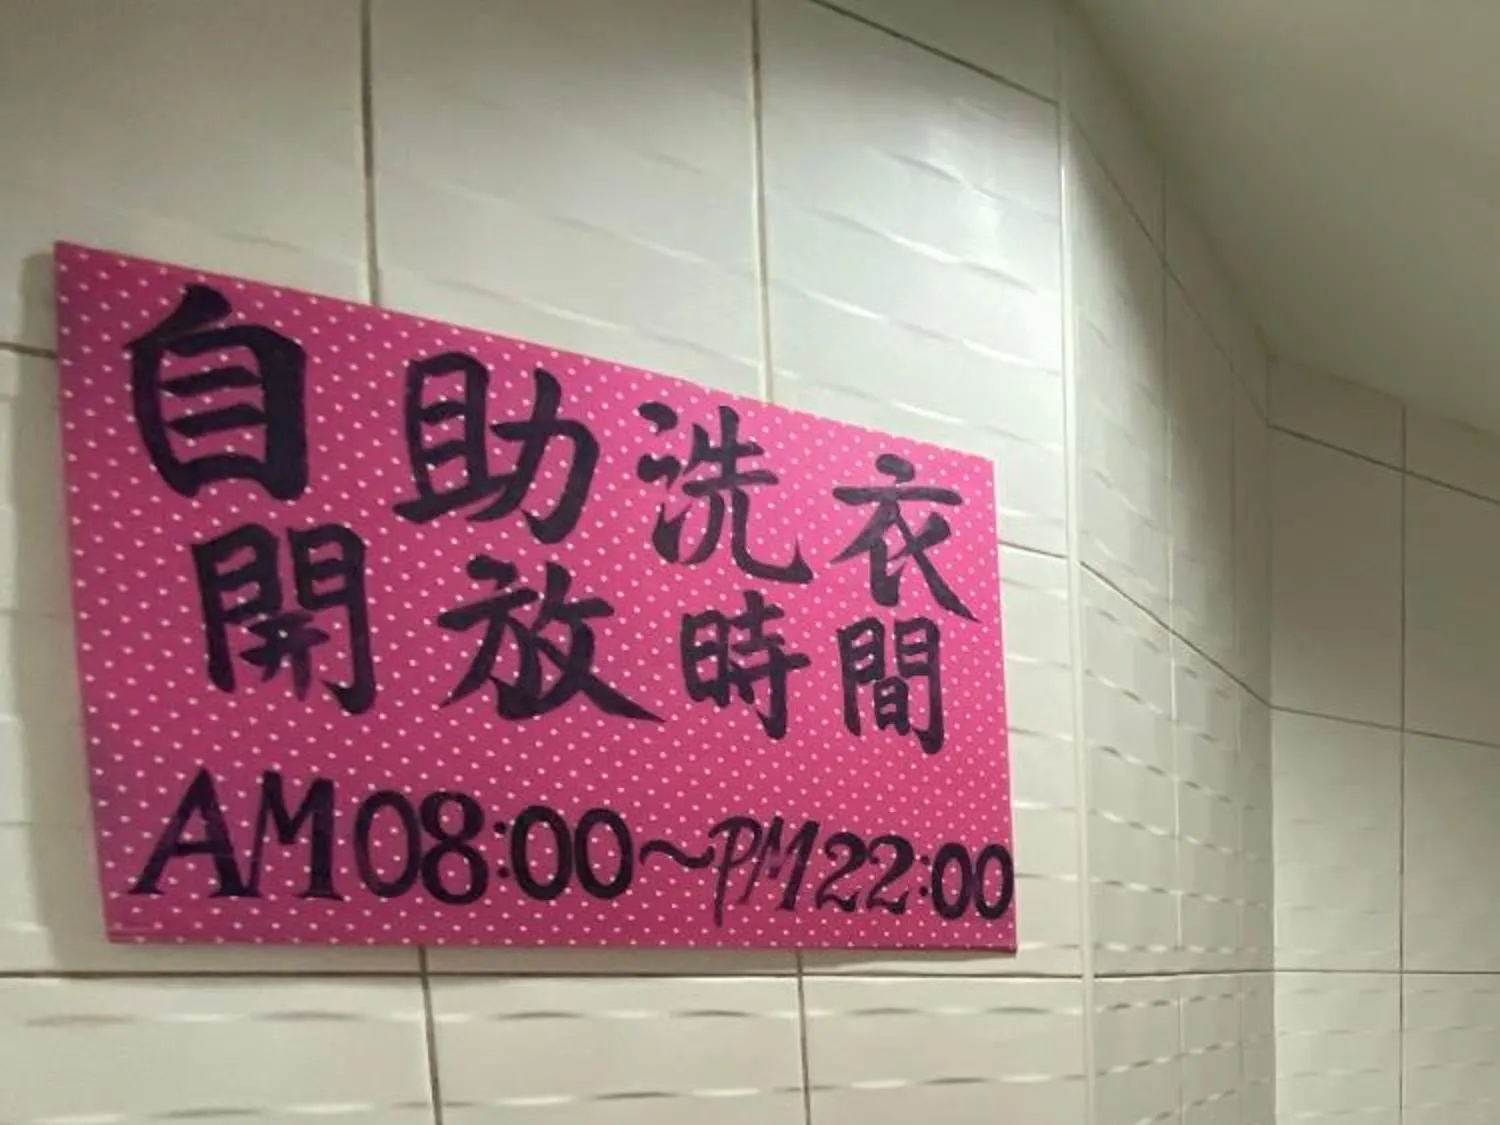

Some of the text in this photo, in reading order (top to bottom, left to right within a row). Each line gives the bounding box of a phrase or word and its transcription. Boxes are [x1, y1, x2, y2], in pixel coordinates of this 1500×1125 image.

[124, 284, 977, 620] 自助洗衣
[192, 522, 945, 754] 開放時間
